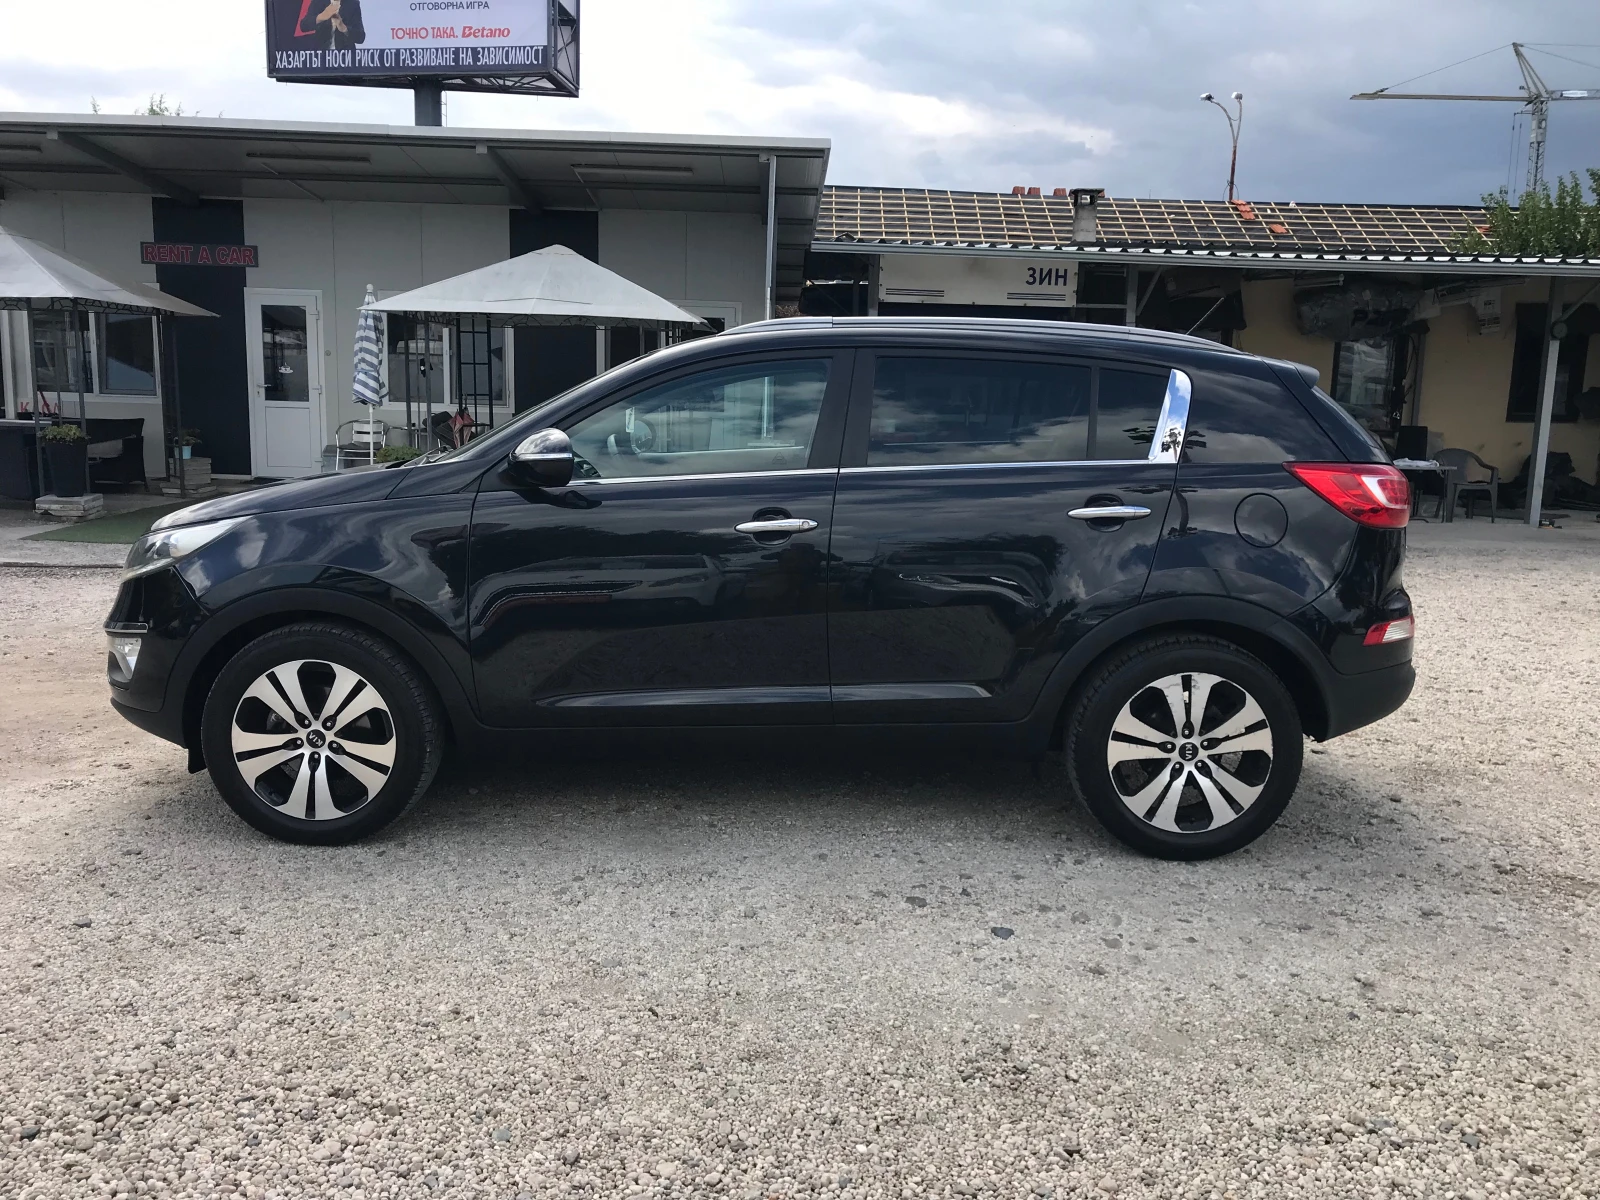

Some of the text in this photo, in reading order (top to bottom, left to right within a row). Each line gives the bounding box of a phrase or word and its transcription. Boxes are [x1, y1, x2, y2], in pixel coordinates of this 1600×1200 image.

[409, 1, 490, 11] ОТГОВОРНА ИГРА
[390, 26, 458, 40] ТОЧНО ТАКА.
[461, 25, 511, 39] Betano
[275, 46, 544, 69] ХАЗАРТЪТ НОСИ РИСК ОТ РАЗВИВАНЕ НА ЗАВИСИМОСТ
[143, 244, 255, 266] RENT A CAR
[1025, 266, 1068, 287] ЗИН
[308, 731, 324, 747] KIA
[1185, 743, 1193, 760] KIA
